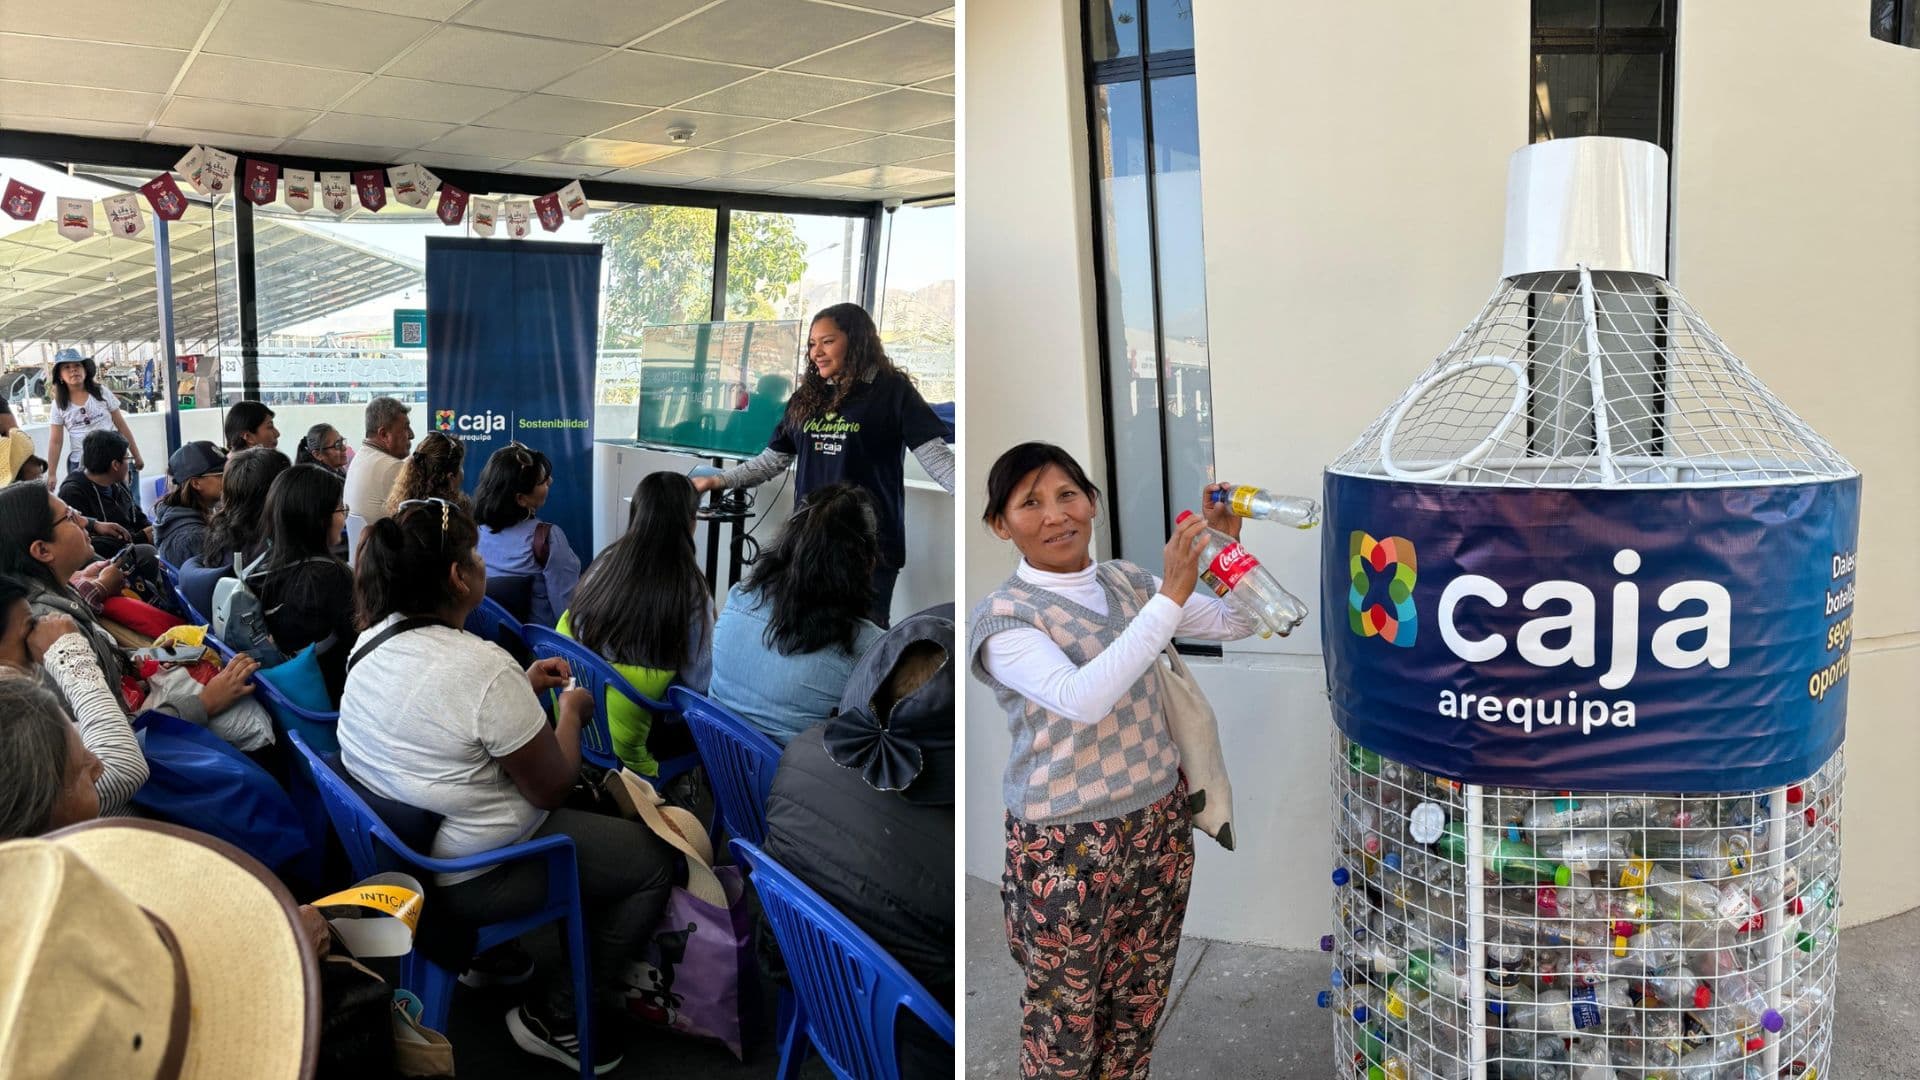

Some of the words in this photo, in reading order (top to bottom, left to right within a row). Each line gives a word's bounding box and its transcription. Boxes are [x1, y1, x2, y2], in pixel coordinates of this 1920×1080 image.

[458, 410, 505, 434] caja
[519, 418, 589, 429] Sostenibilidad
[803, 416, 860, 433] Voluntario
[823, 442, 842, 453] caja
[1438, 549, 1731, 690] caja
[1438, 690, 1636, 735] arequipa
